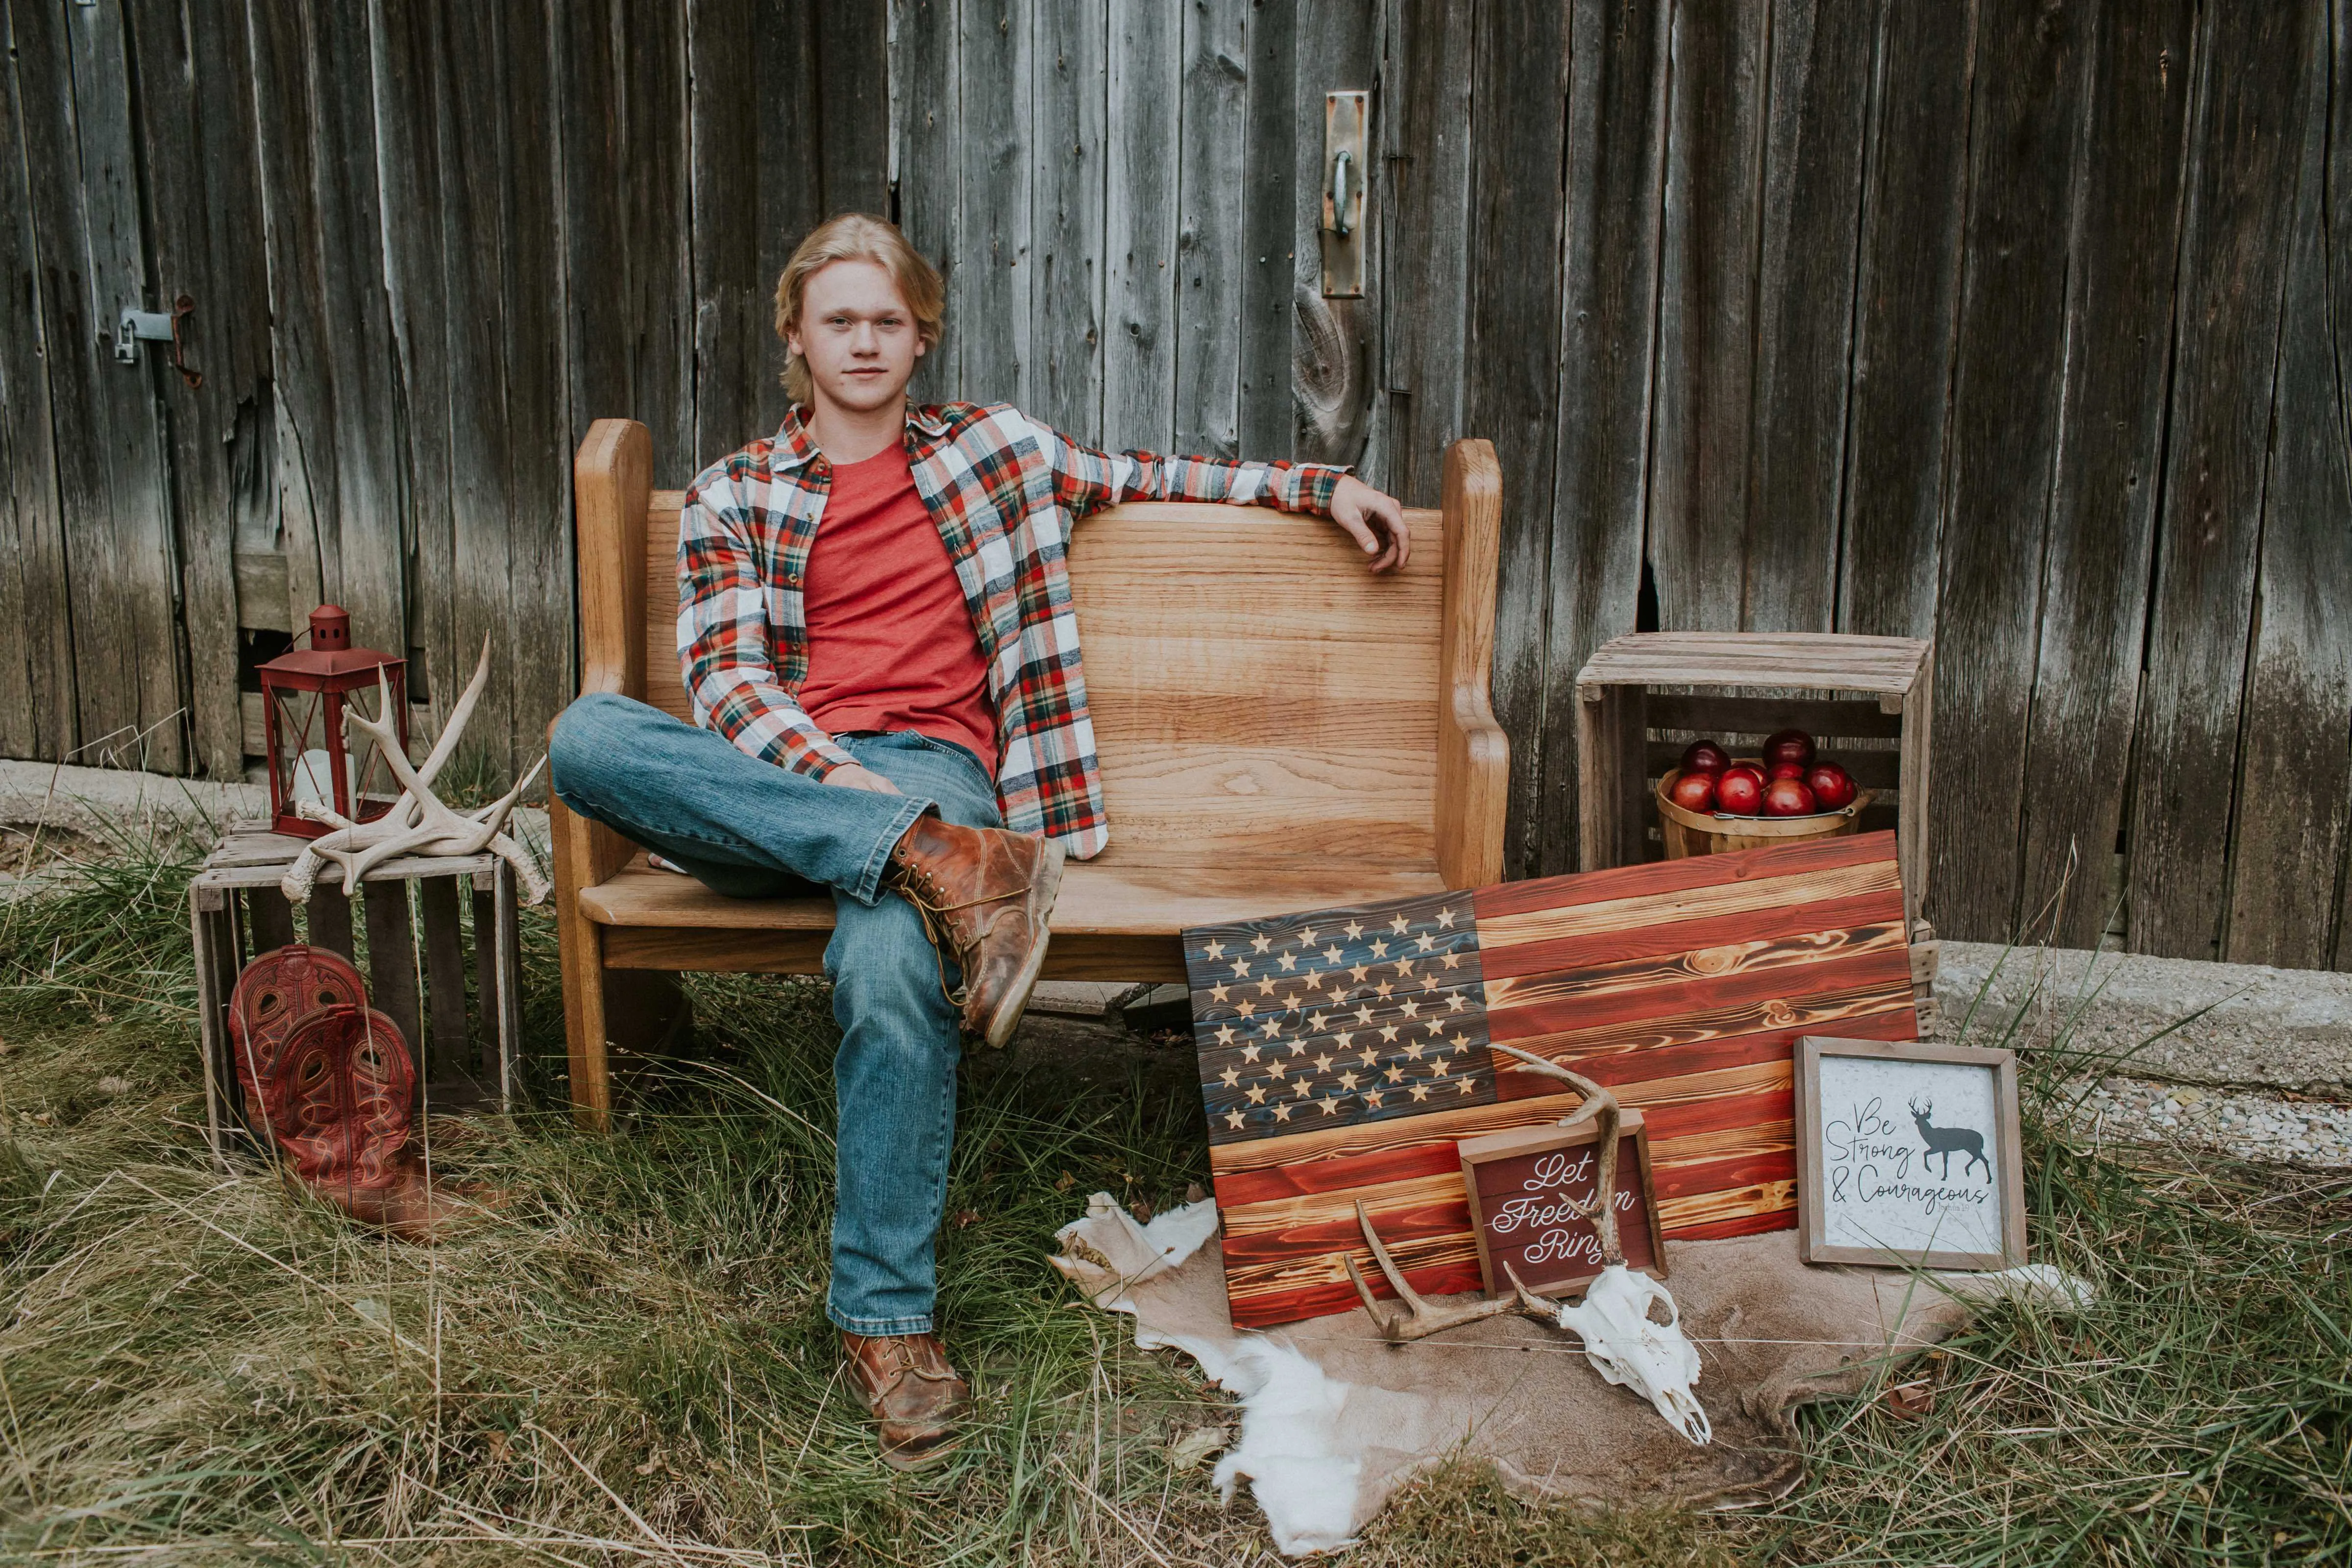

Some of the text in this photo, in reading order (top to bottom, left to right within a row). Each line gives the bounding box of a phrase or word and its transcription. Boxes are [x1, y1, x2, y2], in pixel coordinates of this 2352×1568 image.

[1854, 1097, 1896, 1135] Be
[1524, 1151, 1593, 1191] Let
[1826, 1121, 1915, 1179] Strong
[1493, 1188, 1635, 1233] Freedm
[1833, 1164, 1989, 1215] & Courageous
